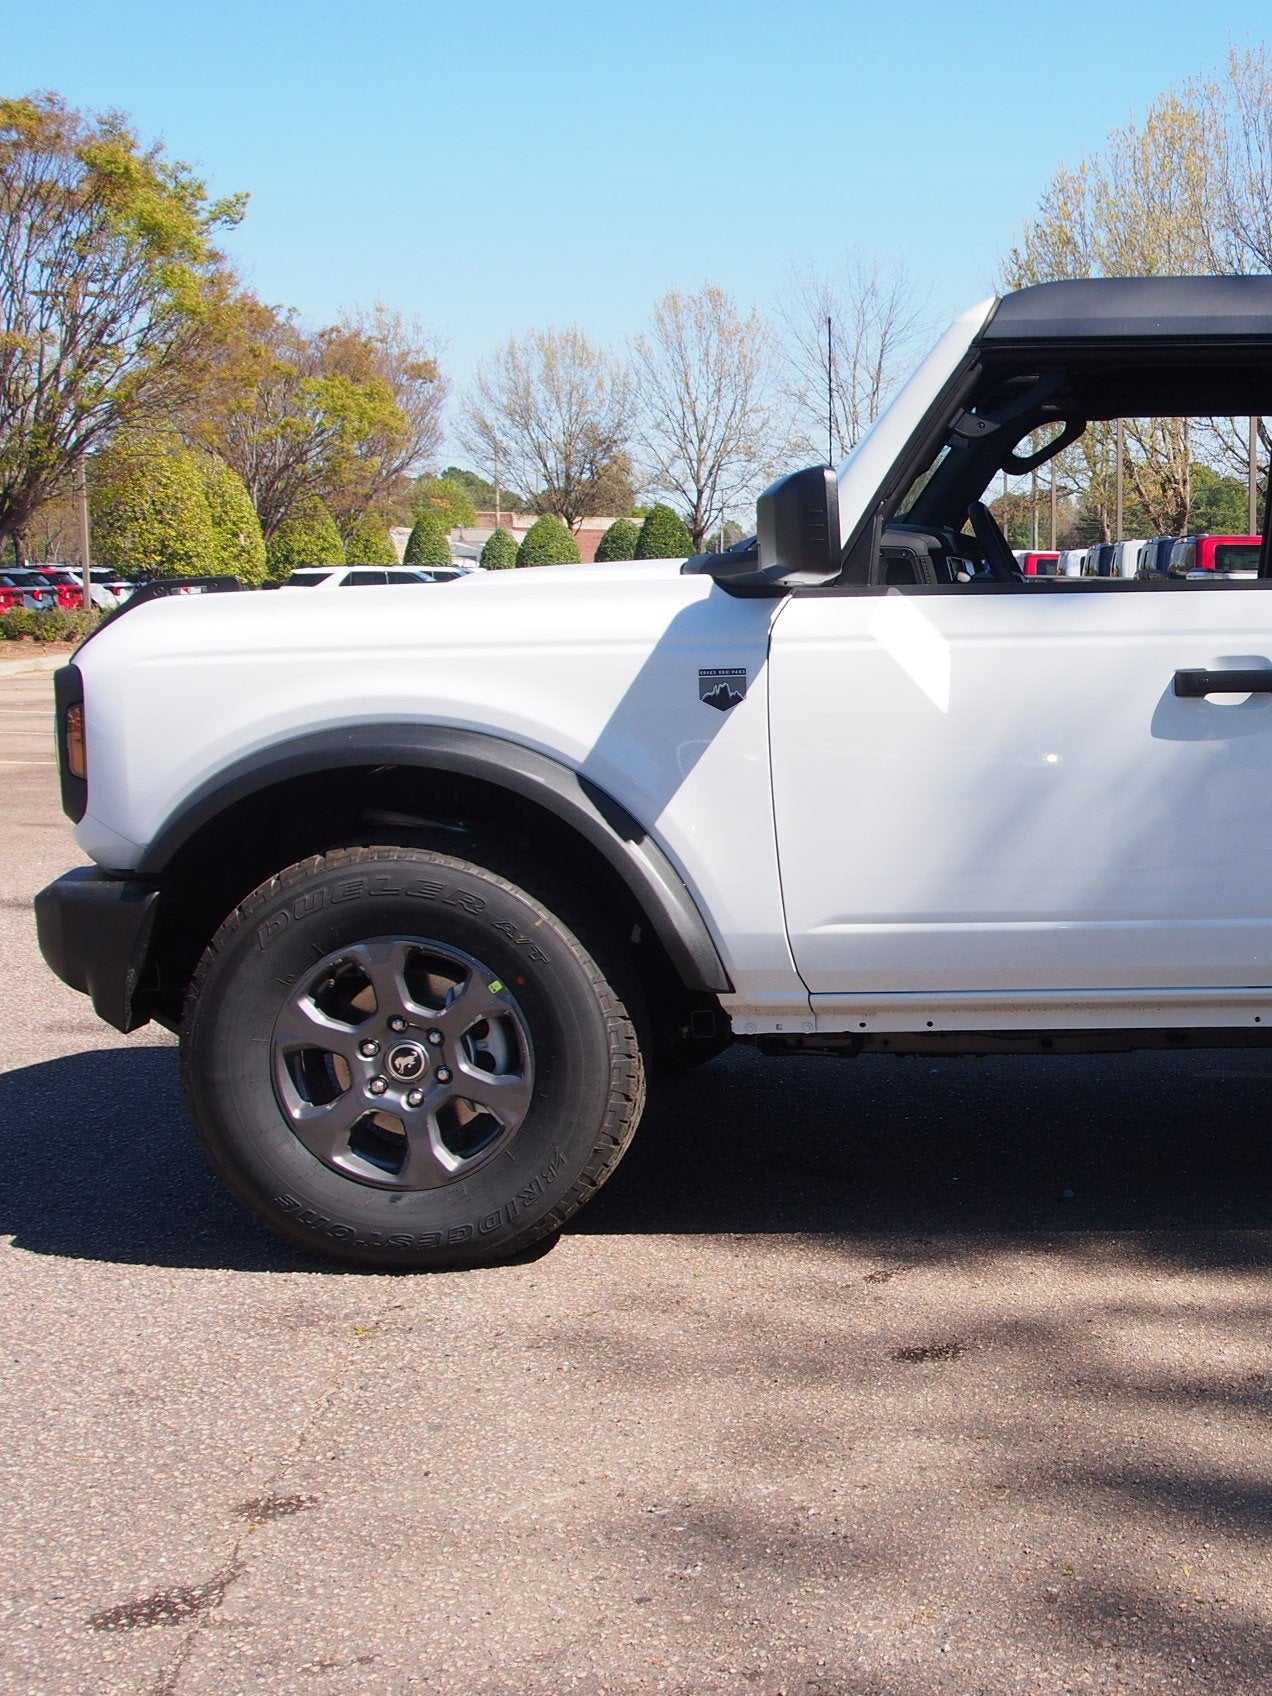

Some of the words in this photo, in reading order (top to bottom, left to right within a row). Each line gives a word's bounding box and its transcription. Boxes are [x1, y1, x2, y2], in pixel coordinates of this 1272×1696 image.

[257, 875, 491, 951] DUELER
[493, 919, 551, 966] A/T
[273, 1143, 567, 1250] BRIDGESTONE
